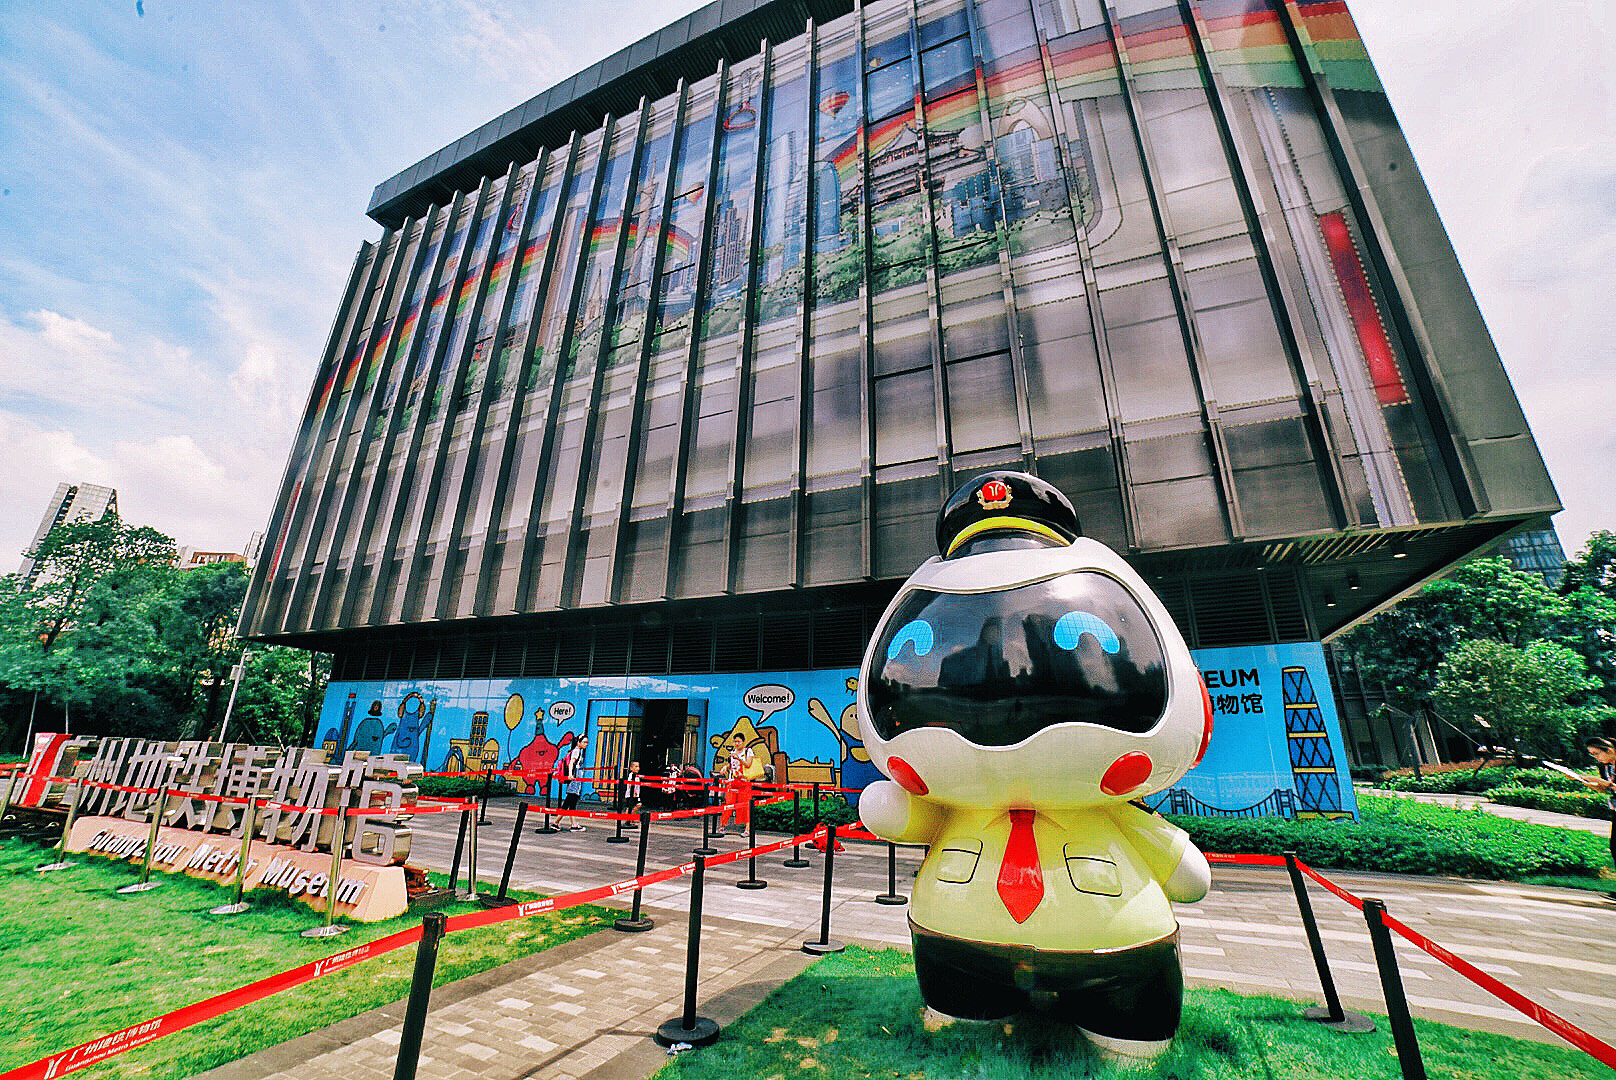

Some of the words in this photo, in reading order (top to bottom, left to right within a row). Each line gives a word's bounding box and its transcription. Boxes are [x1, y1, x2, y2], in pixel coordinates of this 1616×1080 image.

[1203, 668, 1260, 688] EUM
[747, 693, 790, 704] Welcome!
[553, 707, 572, 716] Here!
[258, 855, 367, 904] Museum
